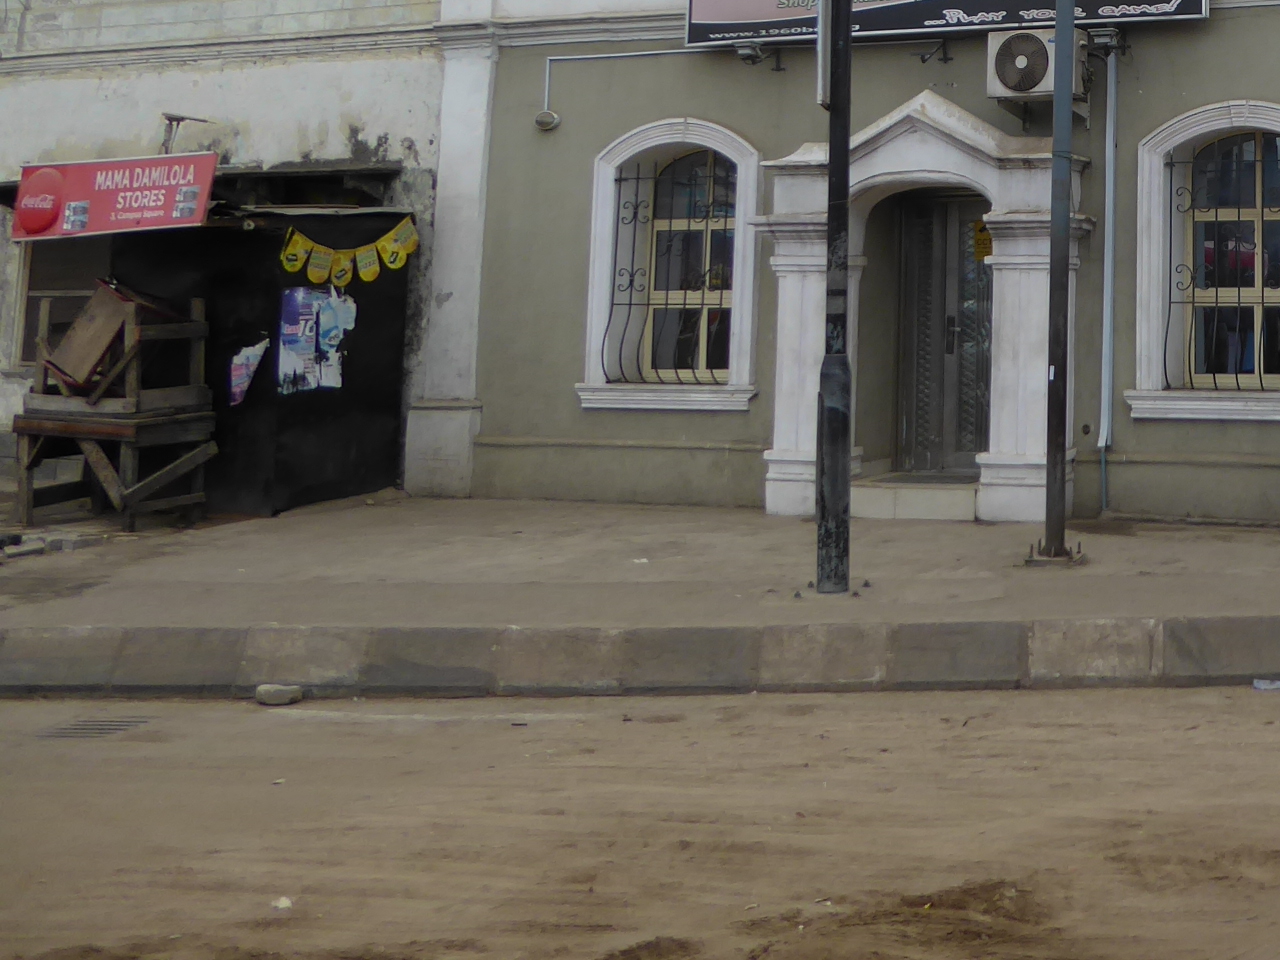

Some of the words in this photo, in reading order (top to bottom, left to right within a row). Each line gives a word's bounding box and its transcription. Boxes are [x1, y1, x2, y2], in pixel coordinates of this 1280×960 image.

[95, 169, 130, 190] MAMA
[133, 164, 195, 188] DAMILOLA
[116, 189, 166, 209] STORES
